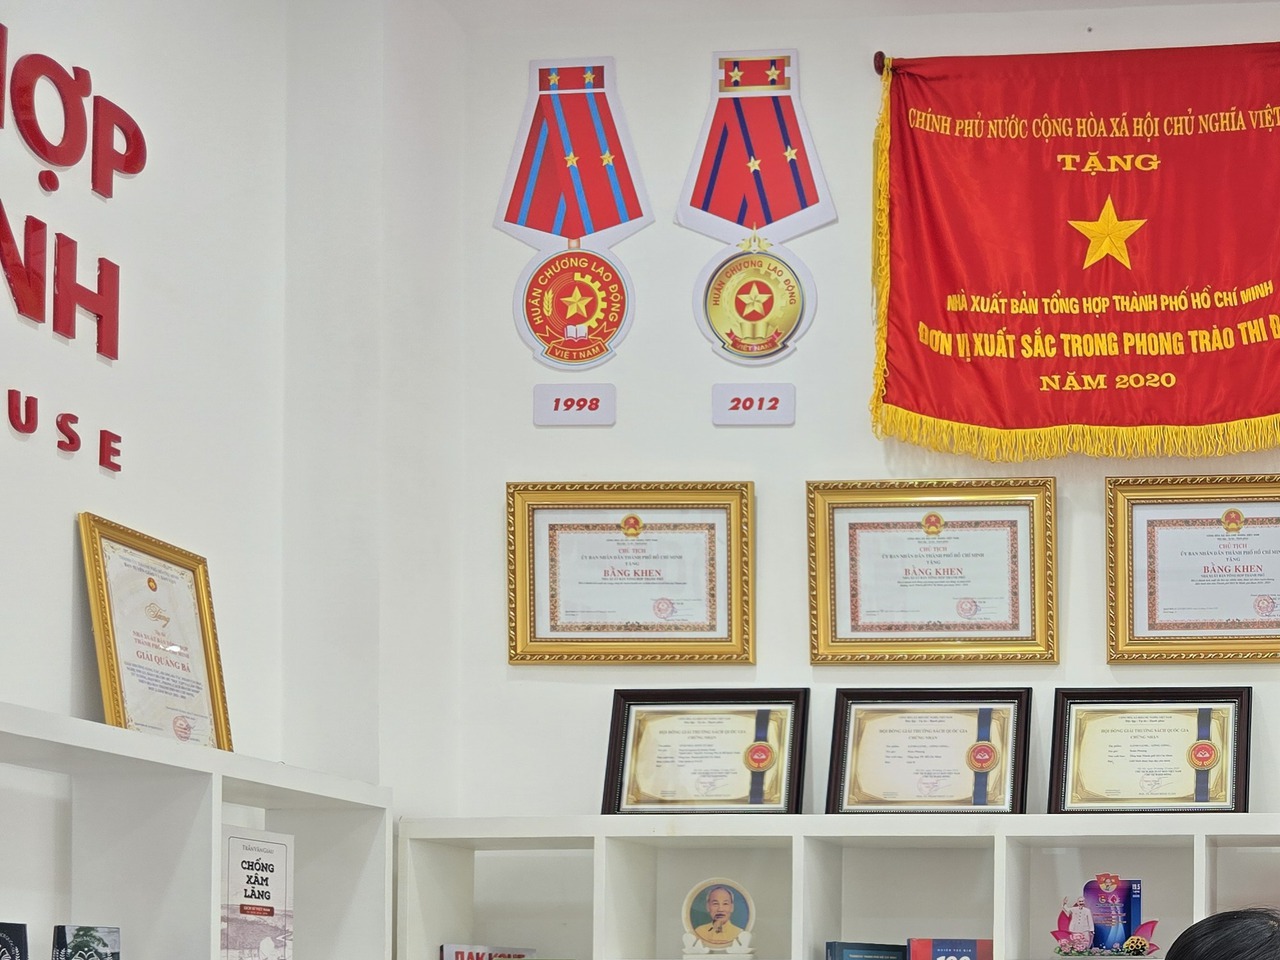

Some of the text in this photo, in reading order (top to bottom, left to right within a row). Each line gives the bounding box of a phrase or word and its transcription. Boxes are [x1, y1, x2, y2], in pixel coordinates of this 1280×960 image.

[907, 108, 951, 135] CHÍNH
[955, 120, 984, 138] PHỦ
[987, 115, 1028, 138] NƯỚC
[1032, 118, 1073, 142] CỘNG
[1076, 118, 1107, 137] HÒA
[1110, 117, 1129, 137] XÃ
[1133, 113, 1159, 142] HỘI
[1164, 108, 1194, 135] CHỦ
[1198, 107, 1246, 133] NGHĨA
[1057, 151, 1161, 175] TẶNG
[531, 256, 622, 325] HUÂN CHƯƠNG LAO ĐỘNG
[947, 280, 1273, 318] NHÀ XUẤT BẢN TỔNG HỢP THÀNH PHỐ HỒ CHÍ MINH
[919, 322, 952, 356] ĐƠN
[956, 334, 970, 362] VỊ
[973, 327, 1015, 358] XUẤT
[1021, 320, 1056, 358] SẮC
[1060, 332, 1119, 357] TRONG
[1123, 332, 1184, 355] PHONG
[1188, 325, 1234, 353] TRÀO
[1237, 318, 1268, 345] THI
[1040, 371, 1176, 391] NĂM 2020
[554, 398, 600, 411] 1998
[728, 397, 779, 410] 2012
[8, 389, 122, 473] USE
[604, 567, 630, 576] BẰNG
[905, 564, 963, 575] BẰNG KHEN
[1204, 563, 1231, 573] BẰNG
[241, 858, 274, 873] CHỐNG
[246, 873, 269, 886] XÂM
[244, 886, 270, 900] LĂNG
